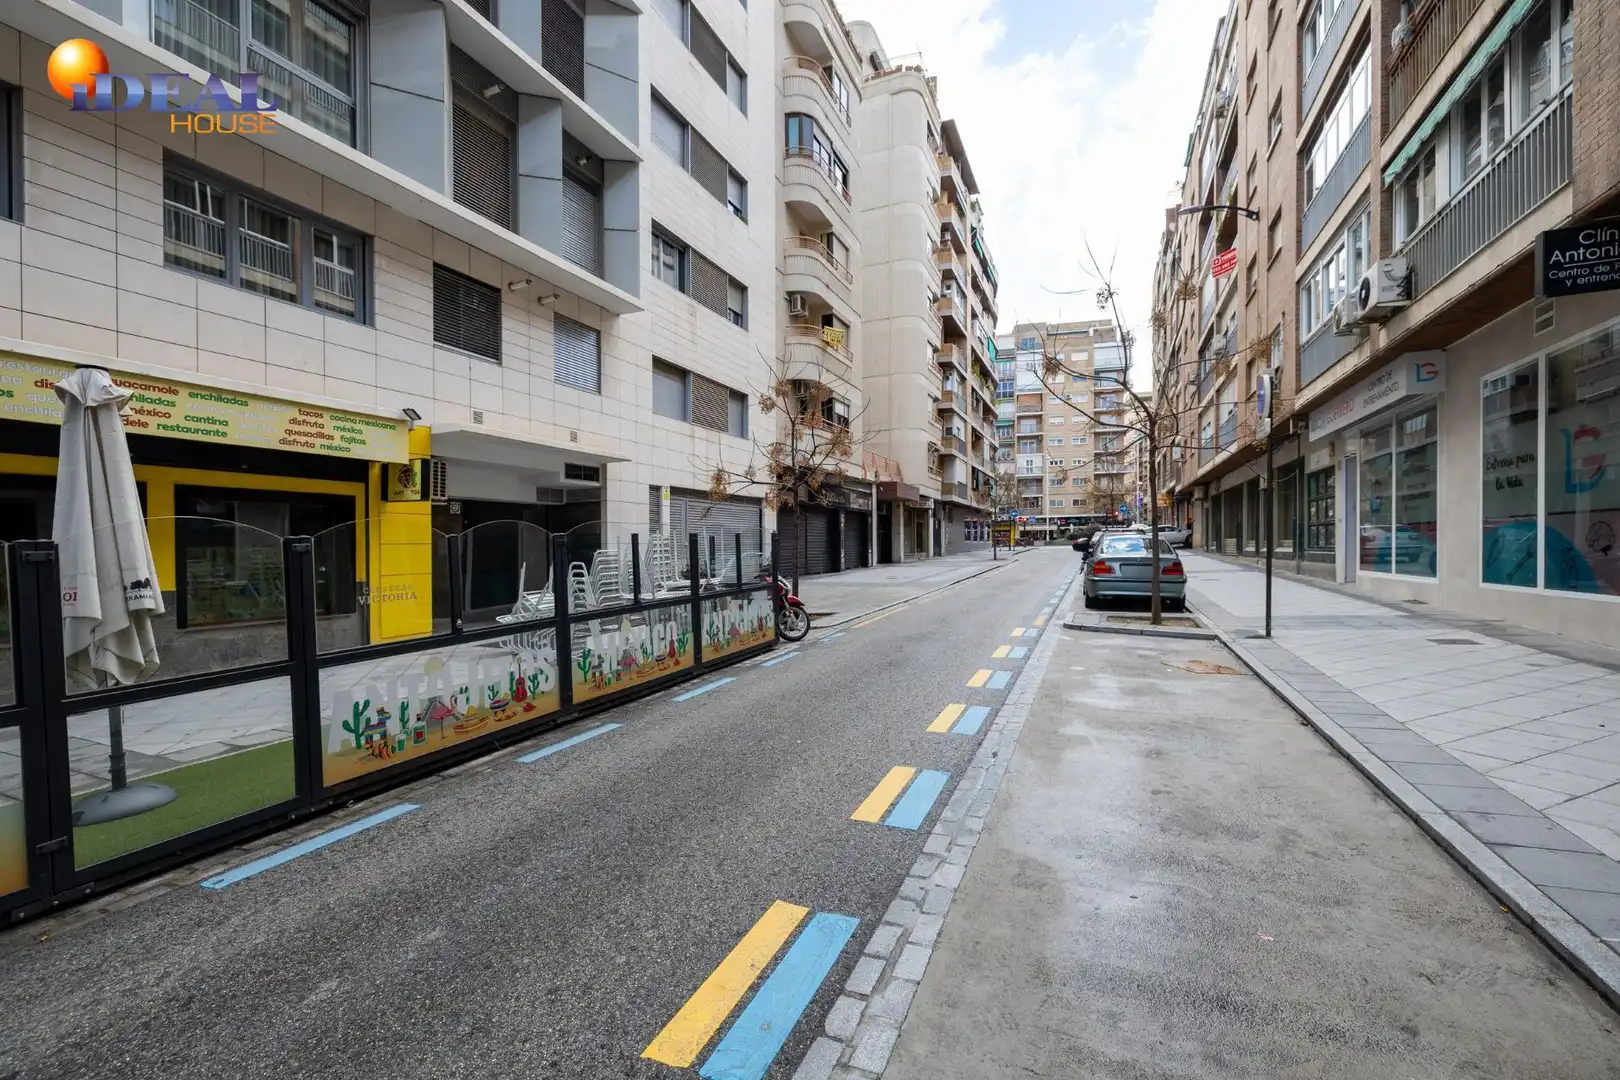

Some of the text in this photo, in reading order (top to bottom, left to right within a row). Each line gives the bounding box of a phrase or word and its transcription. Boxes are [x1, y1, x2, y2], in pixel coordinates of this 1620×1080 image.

[1549, 242, 1620, 265] Antoni
[1549, 267, 1589, 279] Centro
[1594, 264, 1610, 273] de
[1566, 279, 1573, 287] y
[112, 378, 180, 396] uacamole
[188, 390, 249, 407] enchiladas
[298, 408, 324, 419] tacos
[184, 414, 229, 427] cantina
[289, 417, 325, 430] disfruta
[330, 414, 397, 431] cocina mexicana
[157, 422, 228, 438] restaurante
[284, 429, 335, 441] quesadillas
[333, 424, 363, 435] méxico
[279, 437, 316, 449] disfruta
[340, 434, 366, 446] fajitas
[357, 591, 418, 606] VICTORIA
